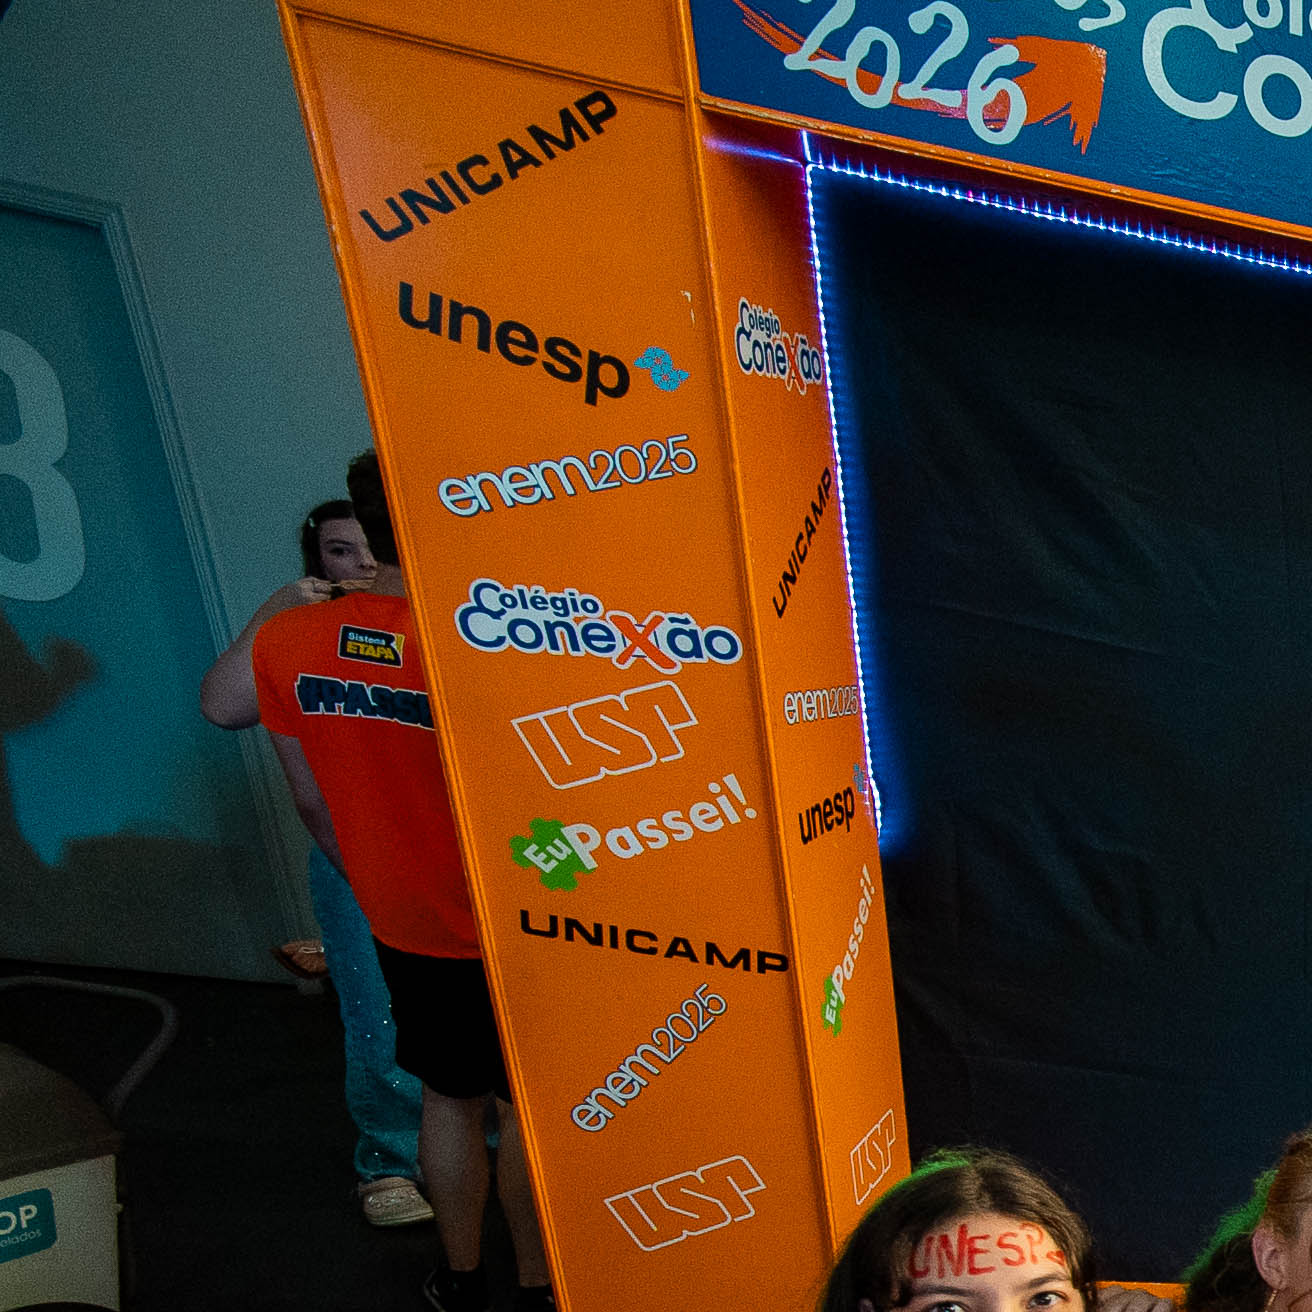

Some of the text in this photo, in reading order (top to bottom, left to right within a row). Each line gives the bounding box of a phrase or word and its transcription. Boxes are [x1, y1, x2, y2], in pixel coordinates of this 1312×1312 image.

[784, 0, 1027, 145] 2026
[359, 90, 617, 243] UNICAMP
[399, 281, 631, 406] unesp
[437, 434, 698, 517] enem2025
[772, 467, 832, 618] UNICAMP
[474, 582, 600, 616] Colégio
[346, 640, 396, 661] ETAPA
[511, 680, 699, 791] USP
[784, 686, 858, 725] enem2025
[522, 773, 758, 874] Eu Passei!
[799, 786, 855, 845] unesp
[519, 909, 790, 976] UNICAMP
[831, 863, 876, 1004] Passei!
[570, 983, 728, 1133] enem2025
[604, 1154, 767, 1252] USP
[850, 1109, 897, 1206] USP
[907, 1221, 1045, 1279] UNESP
